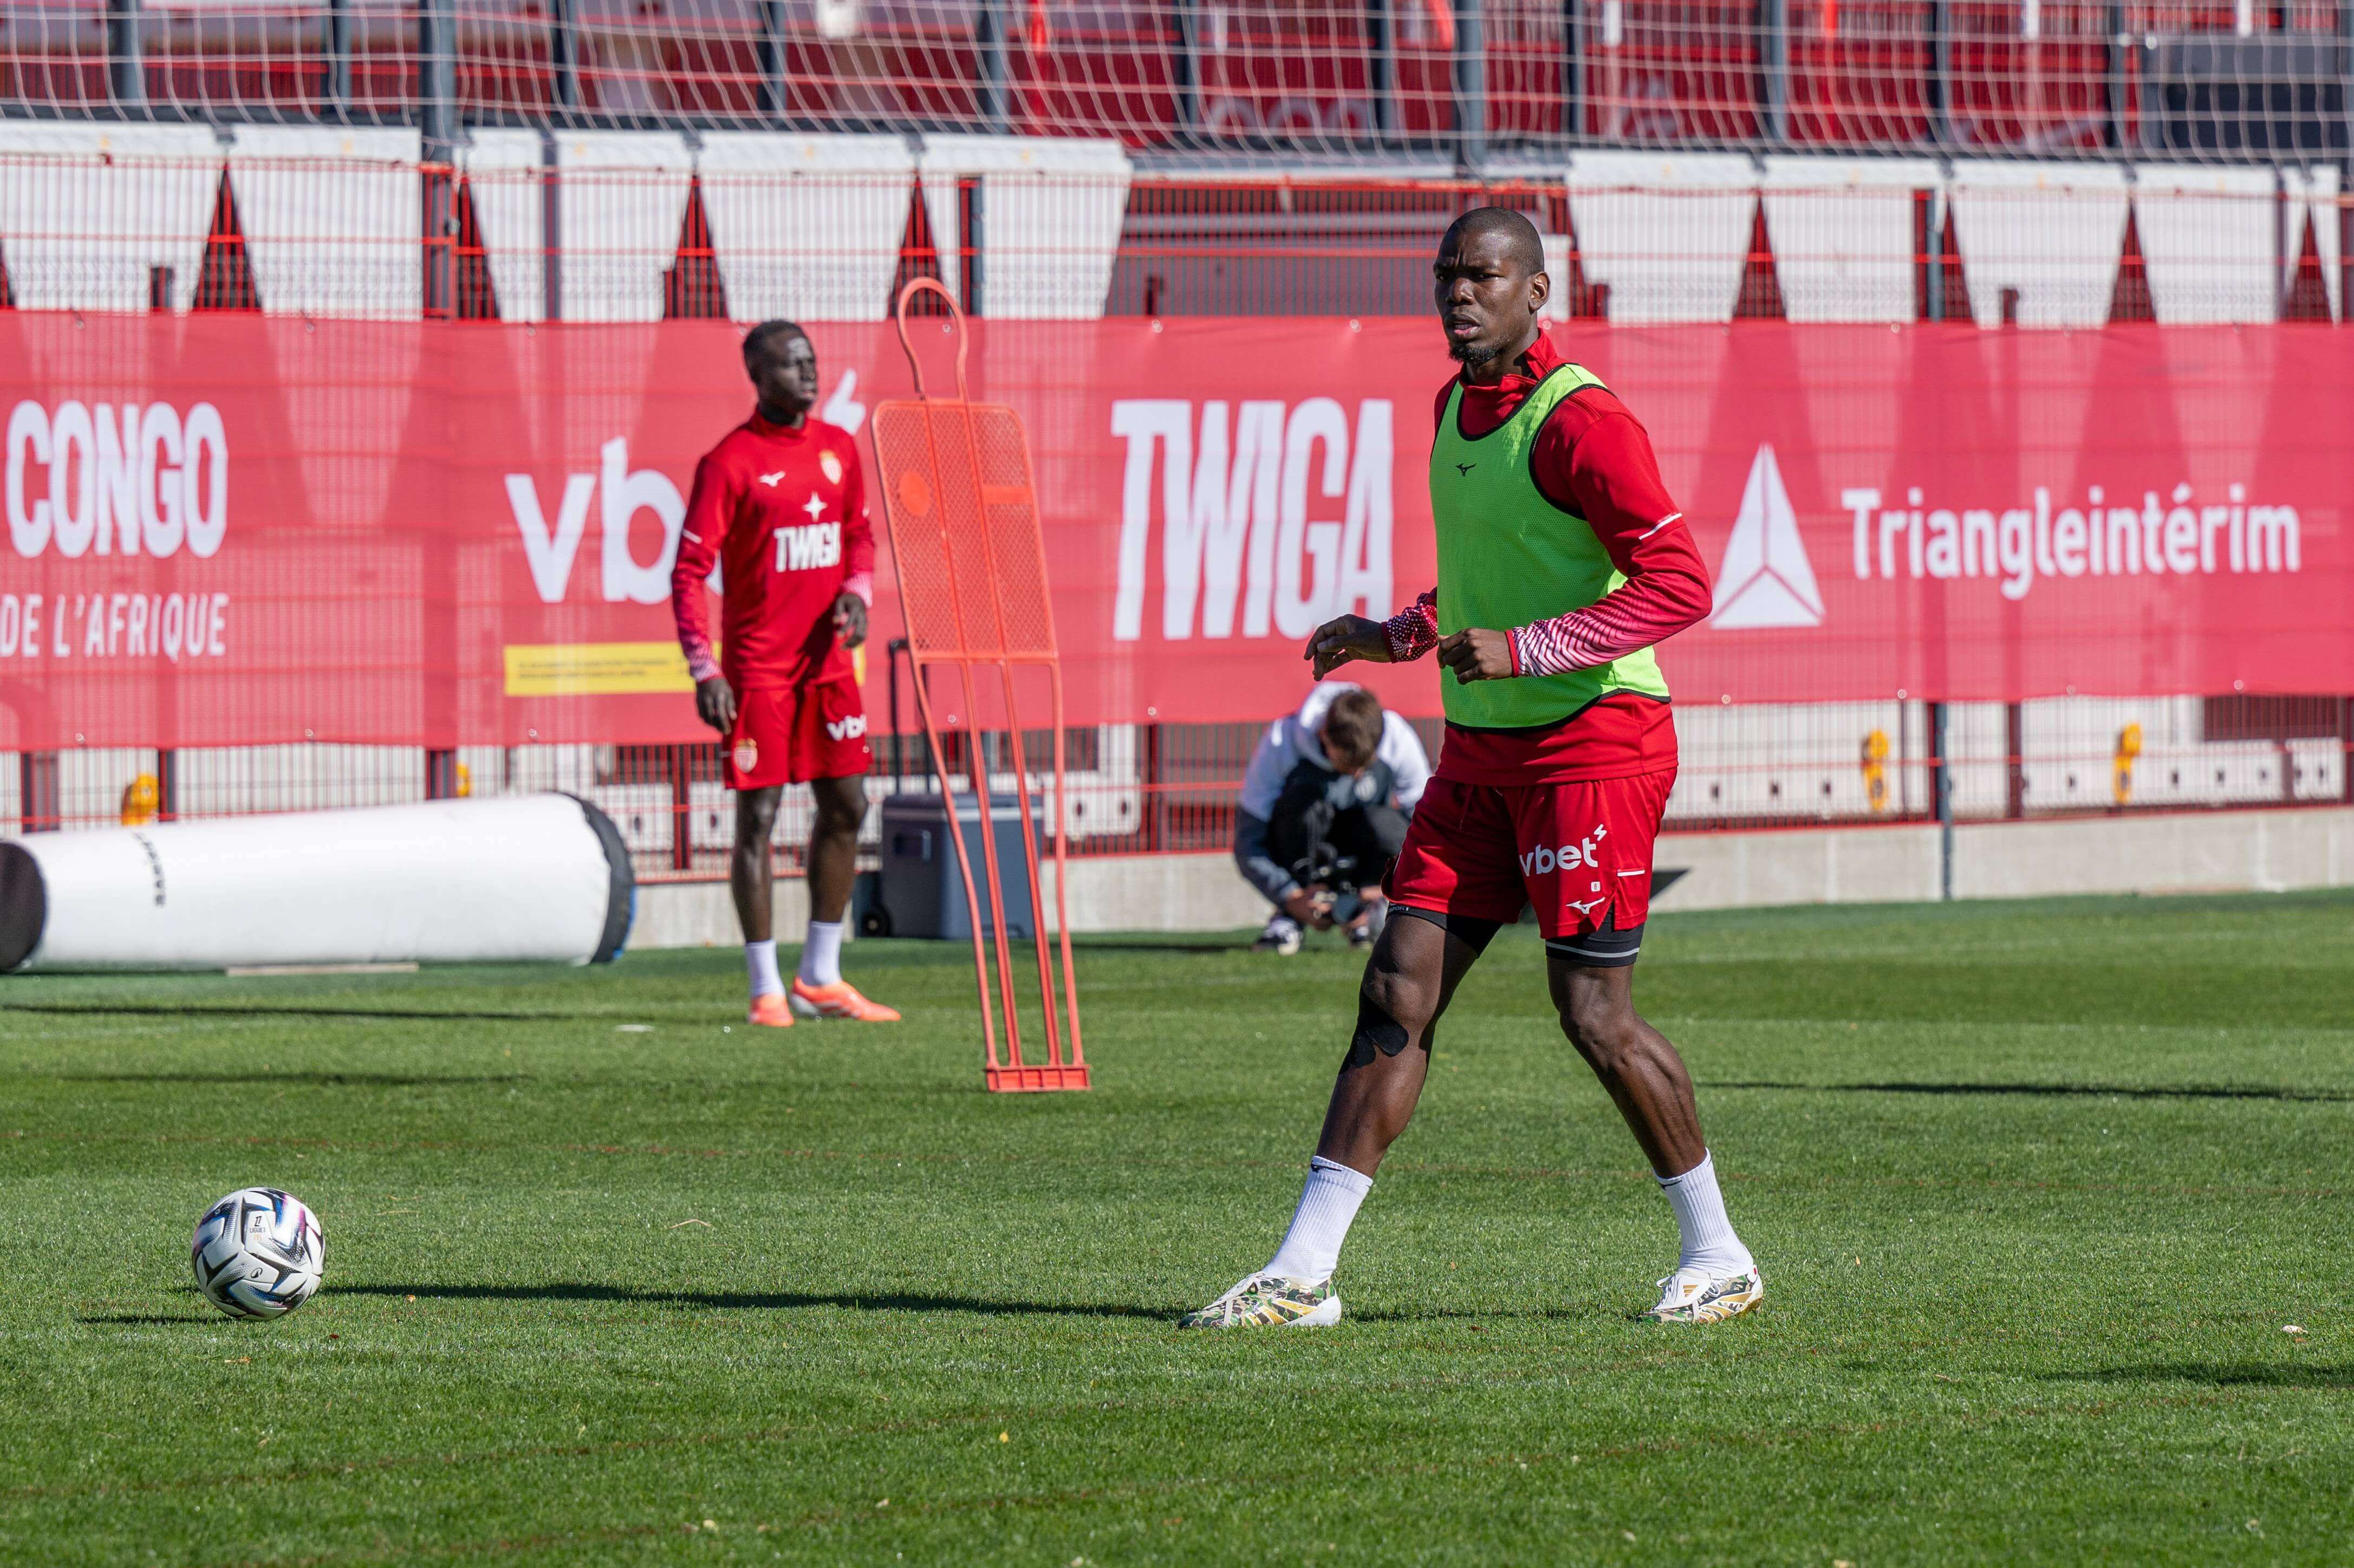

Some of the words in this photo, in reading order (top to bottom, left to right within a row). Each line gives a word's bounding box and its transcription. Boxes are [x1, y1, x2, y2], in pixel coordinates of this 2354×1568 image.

[6, 400, 229, 558] CONGO
[504, 436, 724, 605] vb
[1111, 397, 1394, 641] TWIGA
[1843, 482, 2301, 600] Triangleintérim
[0, 592, 43, 658] DE
[53, 592, 230, 664] L'AFRIQUE
[1519, 837, 1598, 877] vbet
